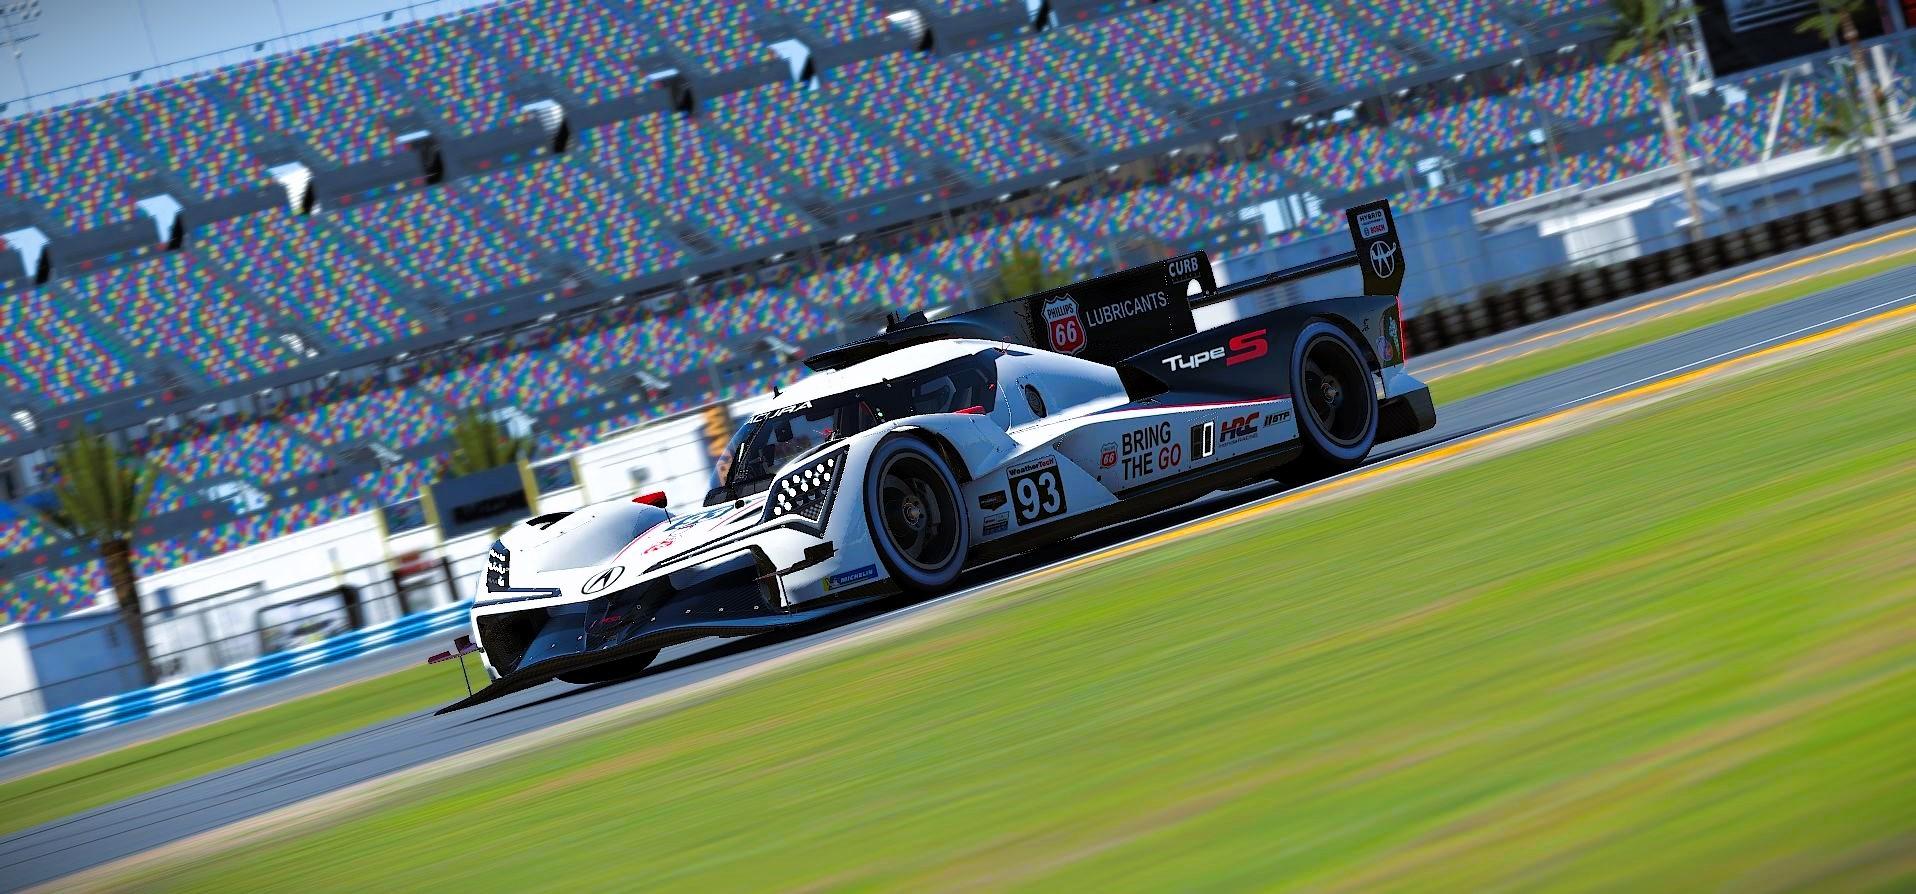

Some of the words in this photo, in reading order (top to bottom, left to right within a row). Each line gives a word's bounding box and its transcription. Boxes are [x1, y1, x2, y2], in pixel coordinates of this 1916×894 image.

[1360, 211, 1382, 222] HYBRID
[1169, 257, 1198, 277] CURB
[1047, 303, 1074, 319] PHILLIPS
[1086, 291, 1167, 327] LUBRICANTS
[1056, 320, 1077, 346] 66
[1162, 346, 1226, 372] Type
[1226, 328, 1268, 367] S
[1122, 421, 1171, 456] BRING
[1220, 411, 1260, 442] HRC
[1009, 458, 1054, 475] WeatherTech
[1103, 452, 1115, 466] 66
[1122, 452, 1153, 480] THE
[1158, 443, 1181, 470] GO
[1016, 471, 1060, 520] 93
[840, 569, 873, 583] MICHELIN
